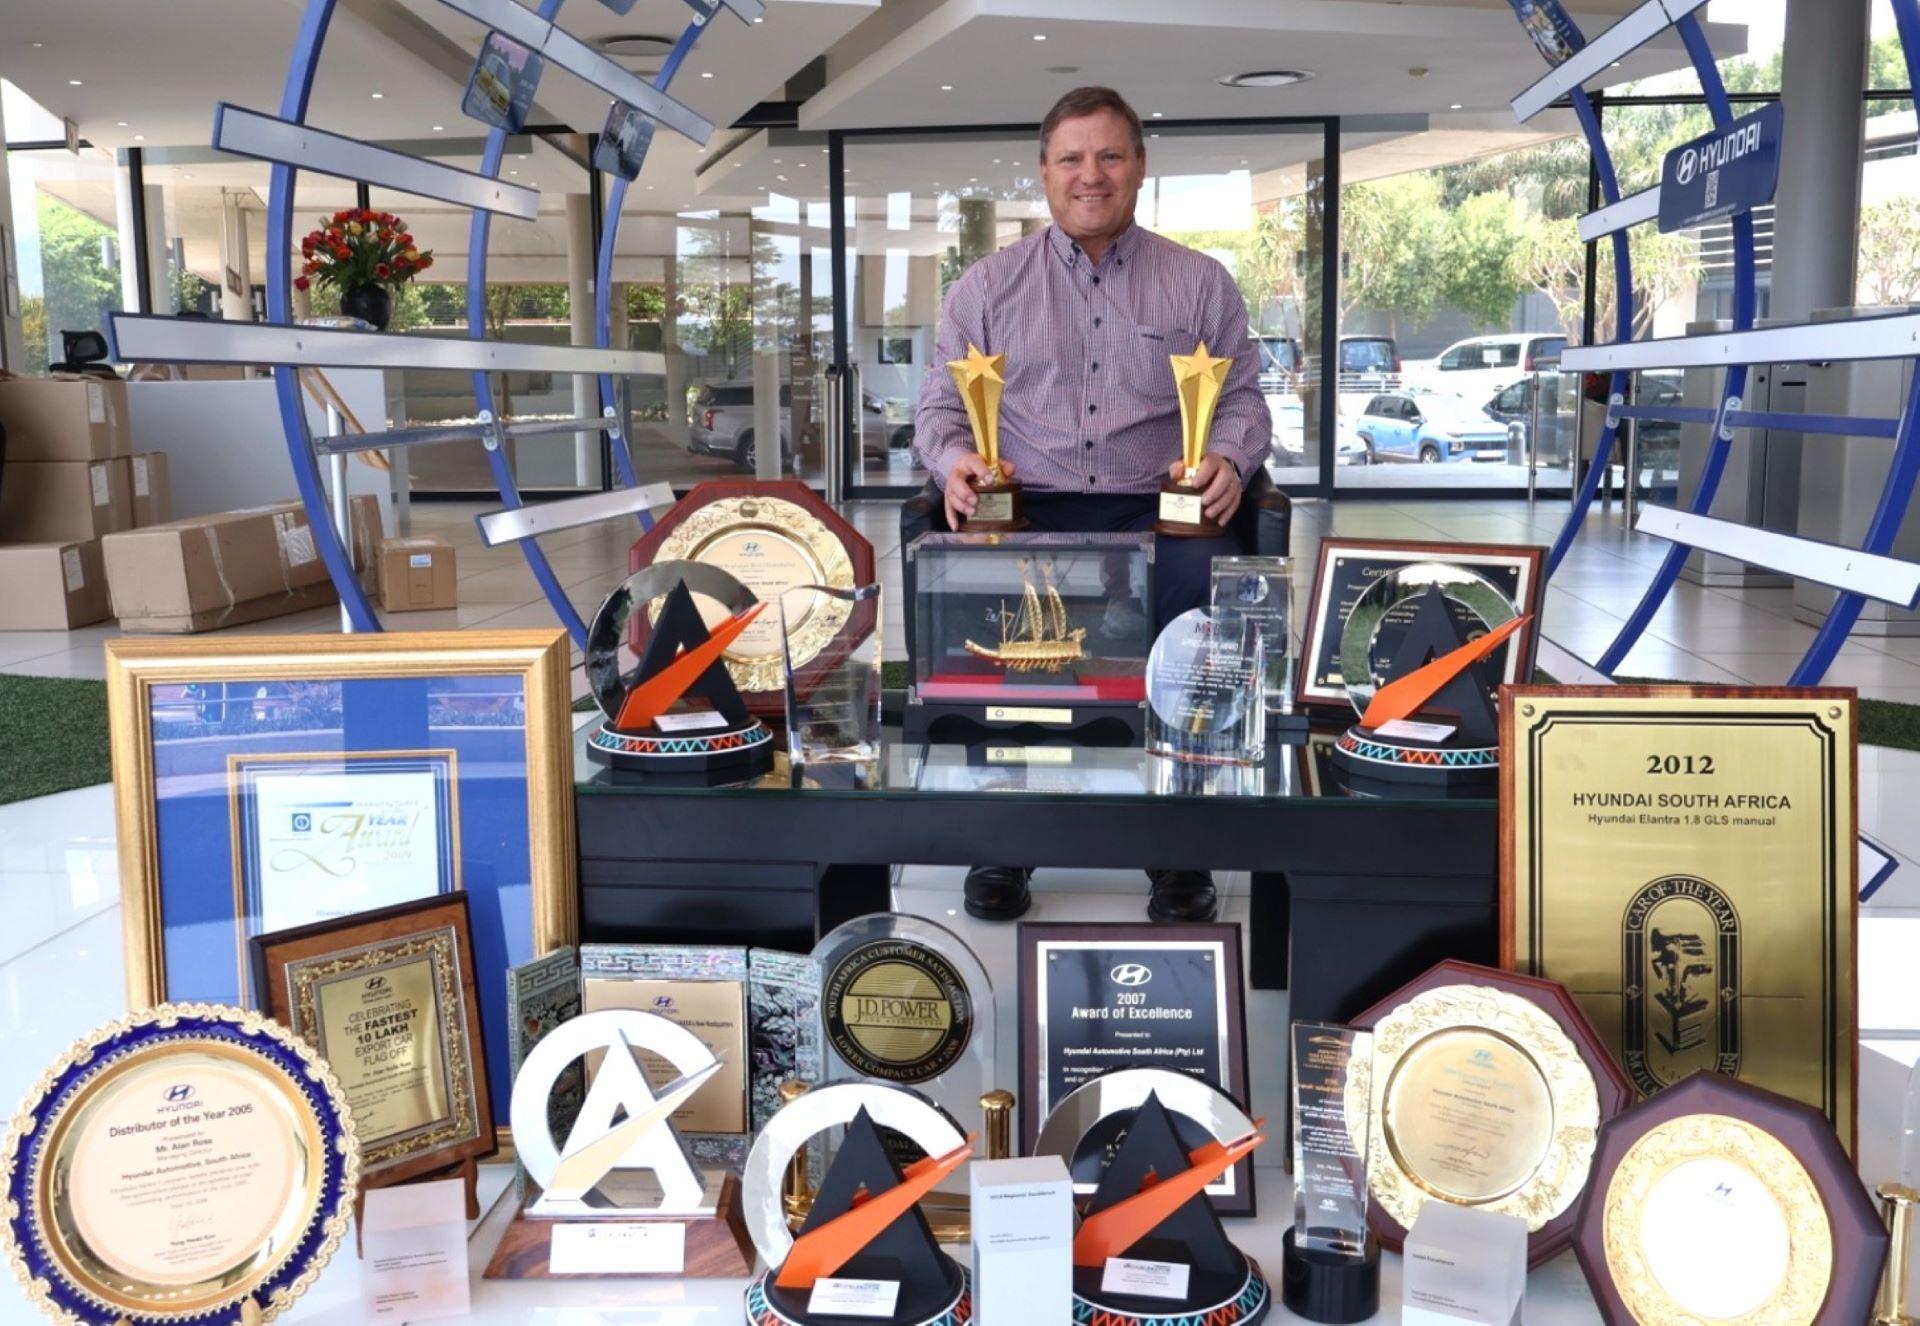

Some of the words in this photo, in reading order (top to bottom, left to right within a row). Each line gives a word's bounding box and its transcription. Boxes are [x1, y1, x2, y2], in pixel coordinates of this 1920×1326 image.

[1700, 121, 1762, 174] HYUNDAI
[1646, 755, 1715, 776] 2012
[1572, 792, 1653, 808] HYUNDAI
[1657, 794, 1719, 809] SOUTH
[1723, 795, 1792, 809] AFRICA
[1588, 813, 1637, 826] Hyundai
[1639, 814, 1681, 826] Elantra
[1685, 815, 1701, 826] 1.8
[1704, 815, 1729, 826] GLS
[1732, 816, 1777, 827] manual
[1628, 897, 1651, 930] CAR
[1649, 884, 1668, 901] OF
[1671, 879, 1705, 899] THE
[1706, 891, 1735, 931] YEAR
[869, 946, 926, 963] CUSTOMER
[882, 999, 940, 1019] POWER
[1117, 993, 1147, 1005] 2007
[348, 999, 412, 1024] CELEBRATING
[1072, 1007, 1108, 1019] Award
[1112, 1007, 1125, 1019] of
[1129, 1007, 1193, 1020] Excellence
[344, 1024, 363, 1036] THE
[365, 1009, 418, 1031] FASTEST
[358, 1032, 371, 1044] 10
[375, 1022, 409, 1040] LAKH
[355, 1040, 391, 1058] EXPORT
[393, 1033, 413, 1046] CAR
[1064, 1047, 1092, 1057] Hyundai
[1093, 1047, 1130, 1055] Automotive
[1132, 1047, 1152, 1055] South
[1154, 1047, 1174, 1055] Africa
[1175, 1047, 1191, 1057] (Pty)
[1192, 1047, 1205, 1055] Ltd
[364, 1051, 388, 1066] FLAG
[389, 1046, 408, 1060] OFF
[836, 1034, 865, 1067] LOWER
[864, 1061, 915, 1078] COMPACT
[916, 1061, 938, 1076] CAR
[157, 1100, 204, 1114] HYUNDAI
[109, 1118, 167, 1138] Distributor
[169, 1117, 181, 1128] of
[184, 1113, 201, 1124] the
[203, 1110, 226, 1121] Year
[228, 1104, 254, 1118] 2005
